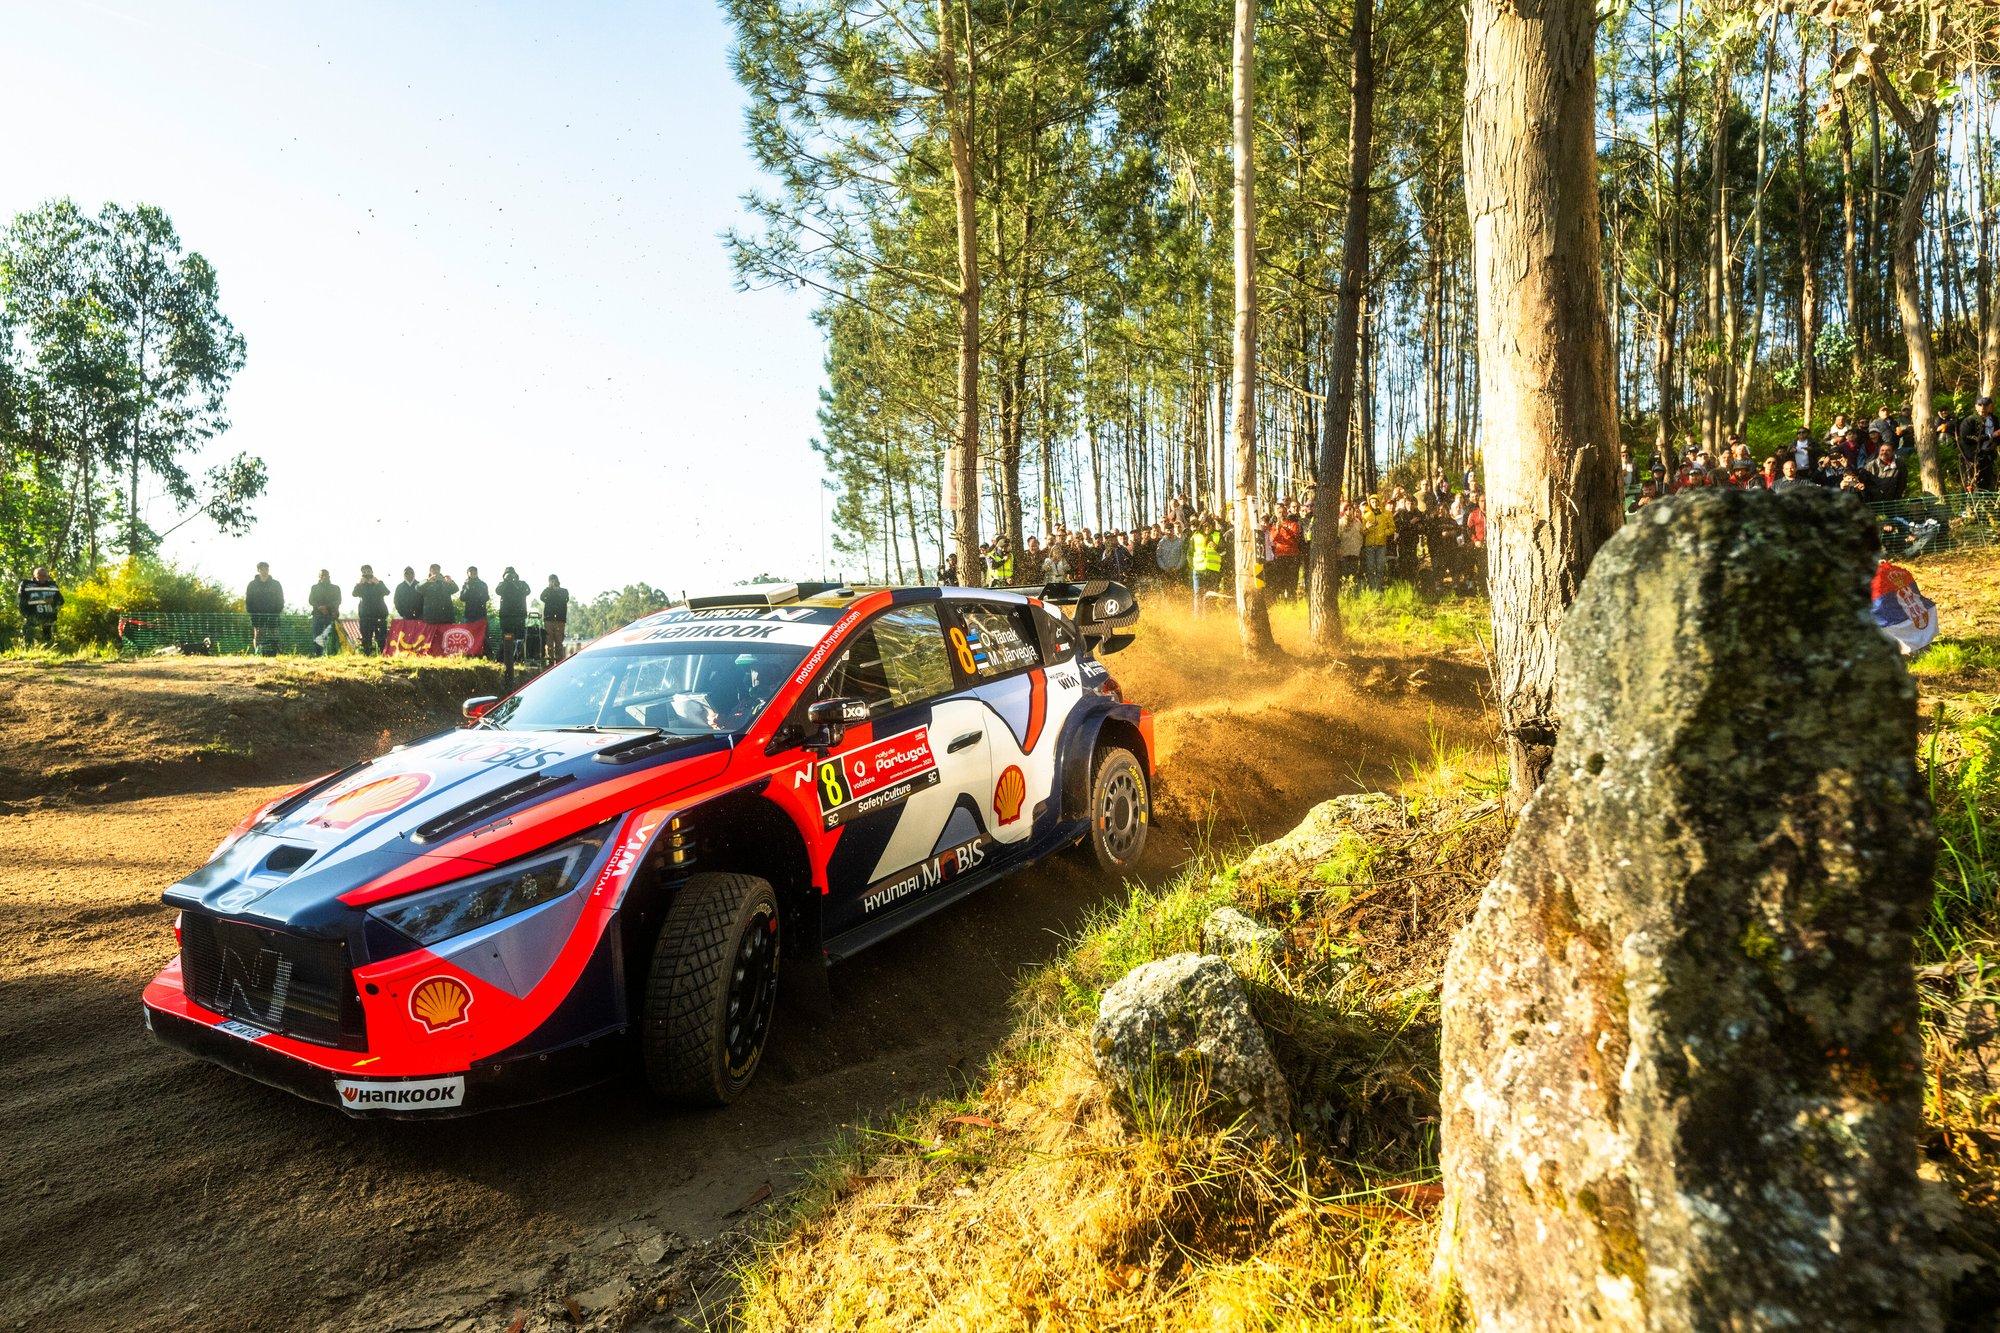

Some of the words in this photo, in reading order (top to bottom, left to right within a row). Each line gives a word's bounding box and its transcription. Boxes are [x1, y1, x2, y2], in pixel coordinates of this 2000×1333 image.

[795, 611, 861, 685] motorsport.hyundai.com
[950, 627, 976, 675] 8
[988, 650, 1002, 666] M.
[875, 743, 930, 773] Portugal
[821, 763, 843, 807] 8
[853, 776, 876, 790] vodafone
[858, 784, 911, 813] SafetyCulture
[594, 845, 626, 896] HYUNDAI
[611, 823, 657, 877] WIA
[864, 875, 920, 913] HYUNDAI
[921, 838, 985, 892] MOBIS
